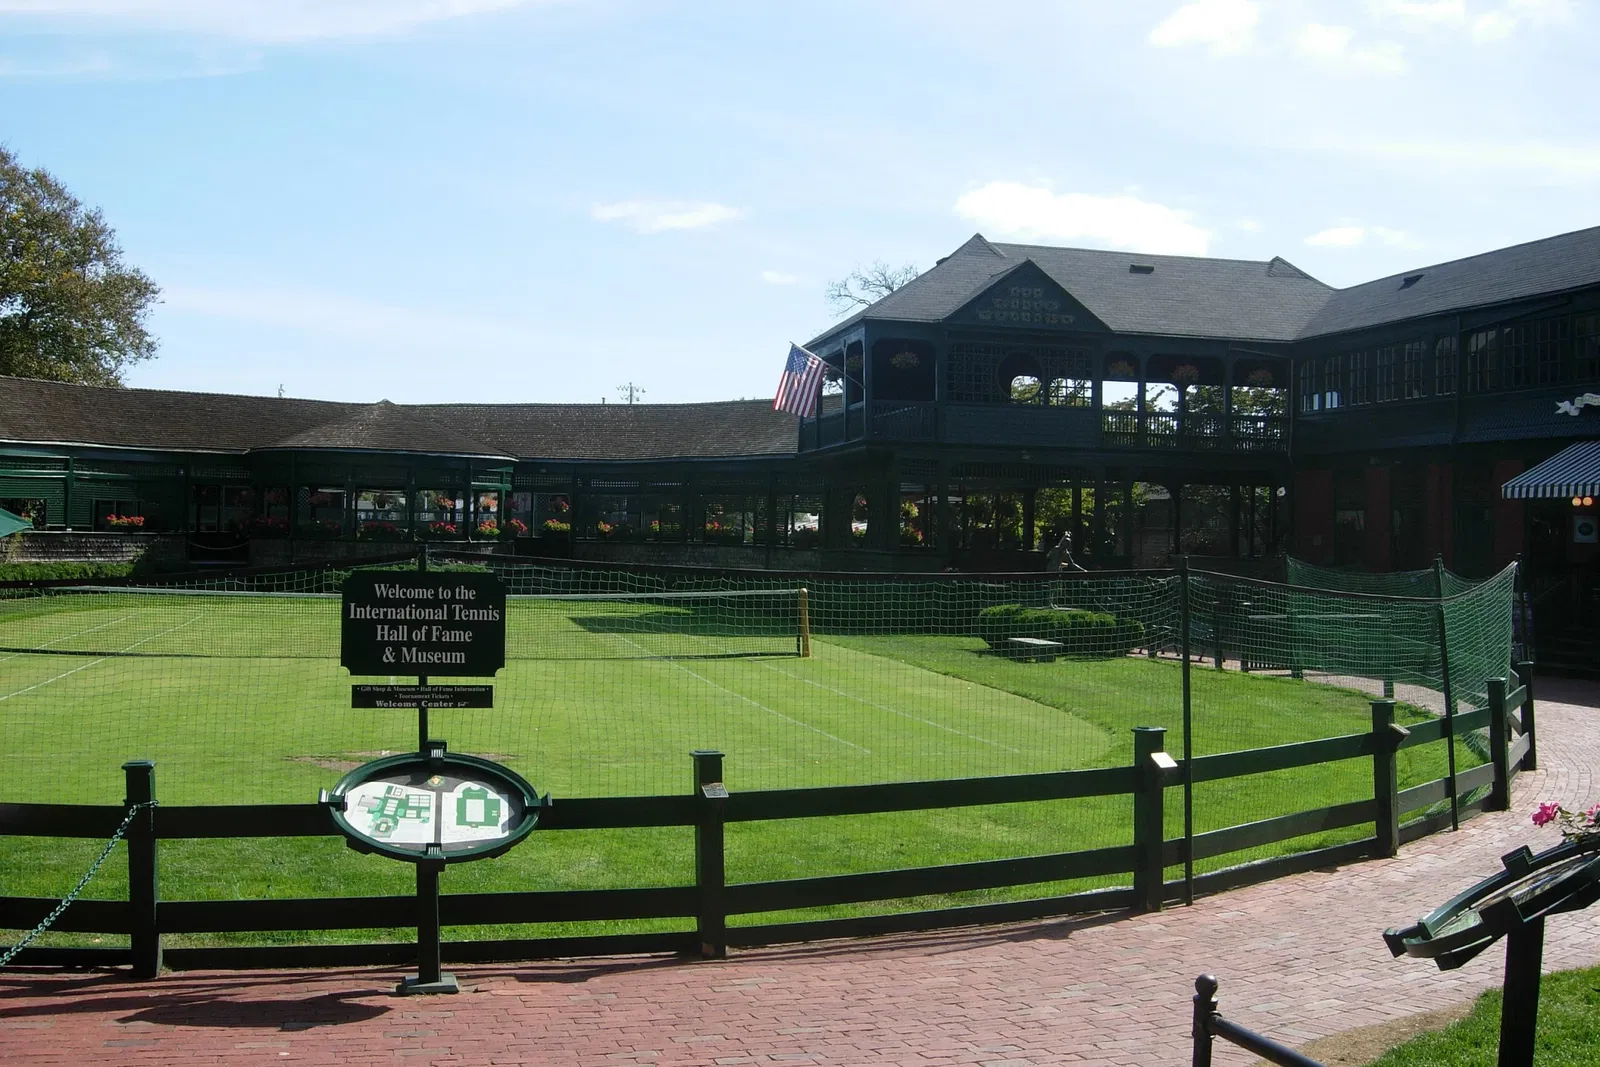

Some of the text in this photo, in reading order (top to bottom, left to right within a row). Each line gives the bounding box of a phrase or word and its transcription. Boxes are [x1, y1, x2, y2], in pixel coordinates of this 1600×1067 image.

[374, 583, 477, 600] Welcome to the
[349, 602, 500, 621] International Tennis
[376, 624, 473, 643] Hall of Fame
[383, 646, 466, 663] & Museum
[376, 700, 454, 708] Welcome Center
